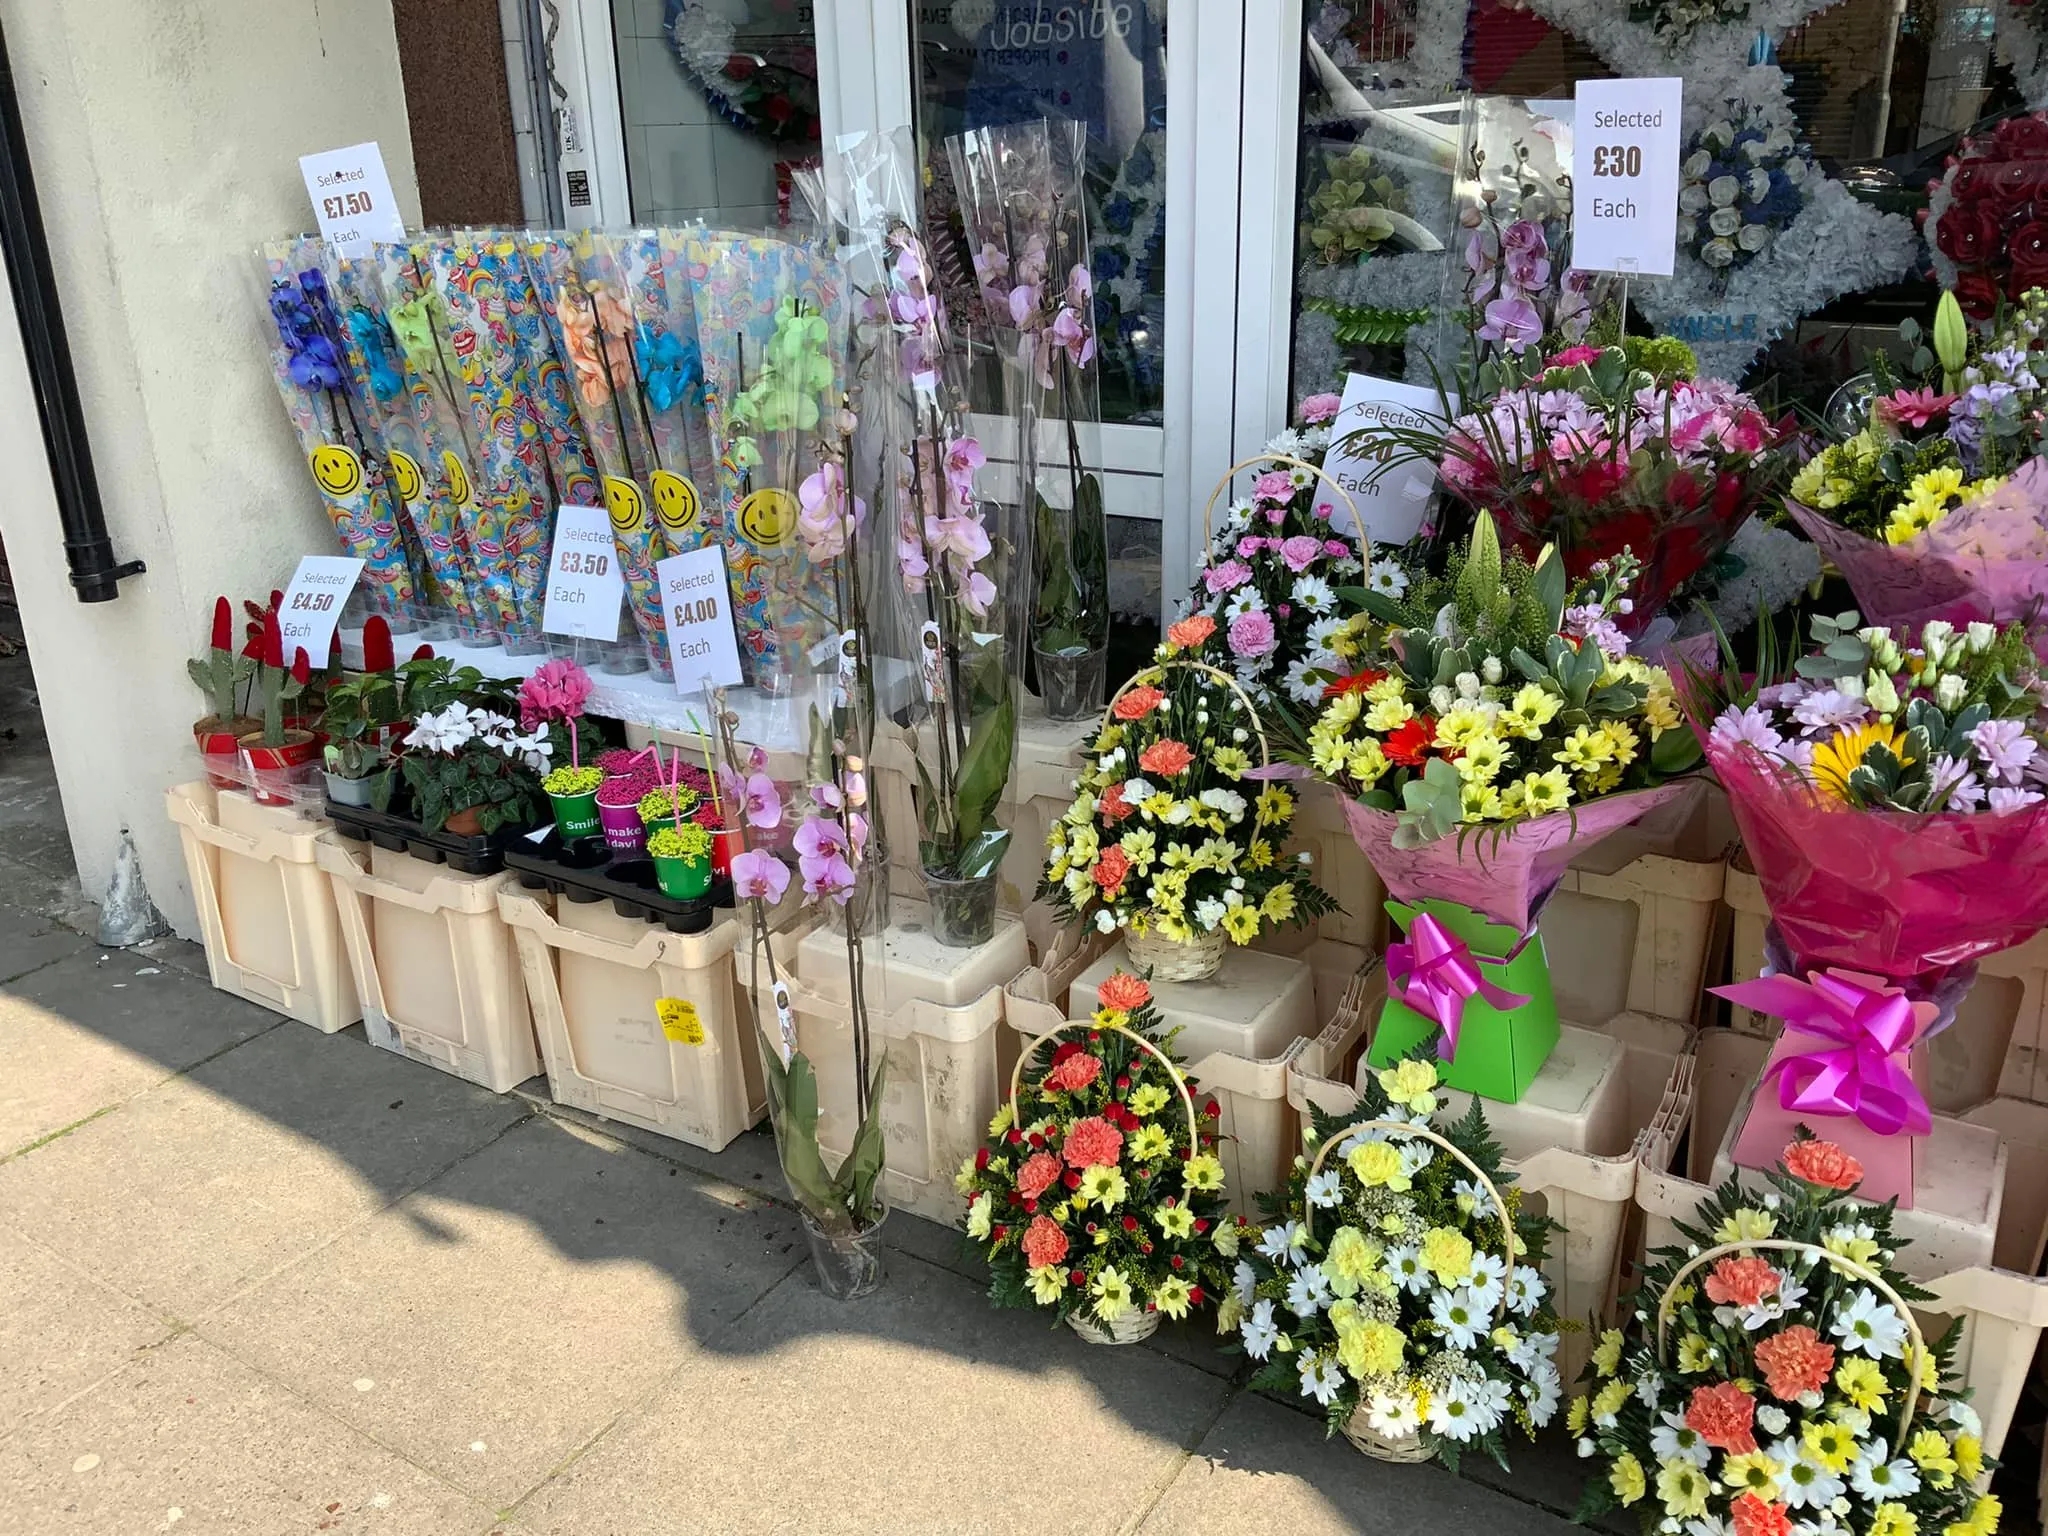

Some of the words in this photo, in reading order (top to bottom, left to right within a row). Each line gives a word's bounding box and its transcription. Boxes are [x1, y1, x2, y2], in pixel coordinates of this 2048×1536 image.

[990, 0, 1133, 51] Jobsite
[1593, 109, 1662, 128] Selected
[1593, 145, 1641, 177] £30
[316, 167, 365, 188] Selected
[323, 191, 373, 219] £7.50
[1593, 198, 1636, 218] Each
[333, 228, 361, 243] Each
[1354, 402, 1425, 429] Selected
[1343, 433, 1394, 464] £20
[1336, 472, 1381, 497] Each
[560, 551, 608, 576] £3.50
[302, 572, 347, 585] Selected
[670, 569, 715, 593] Selected
[291, 592, 335, 612] £4.50
[554, 585, 585, 603] Each
[674, 597, 718, 627] £4.00
[283, 622, 312, 637] Each
[680, 637, 711, 659] Each
[608, 827, 642, 837] make
